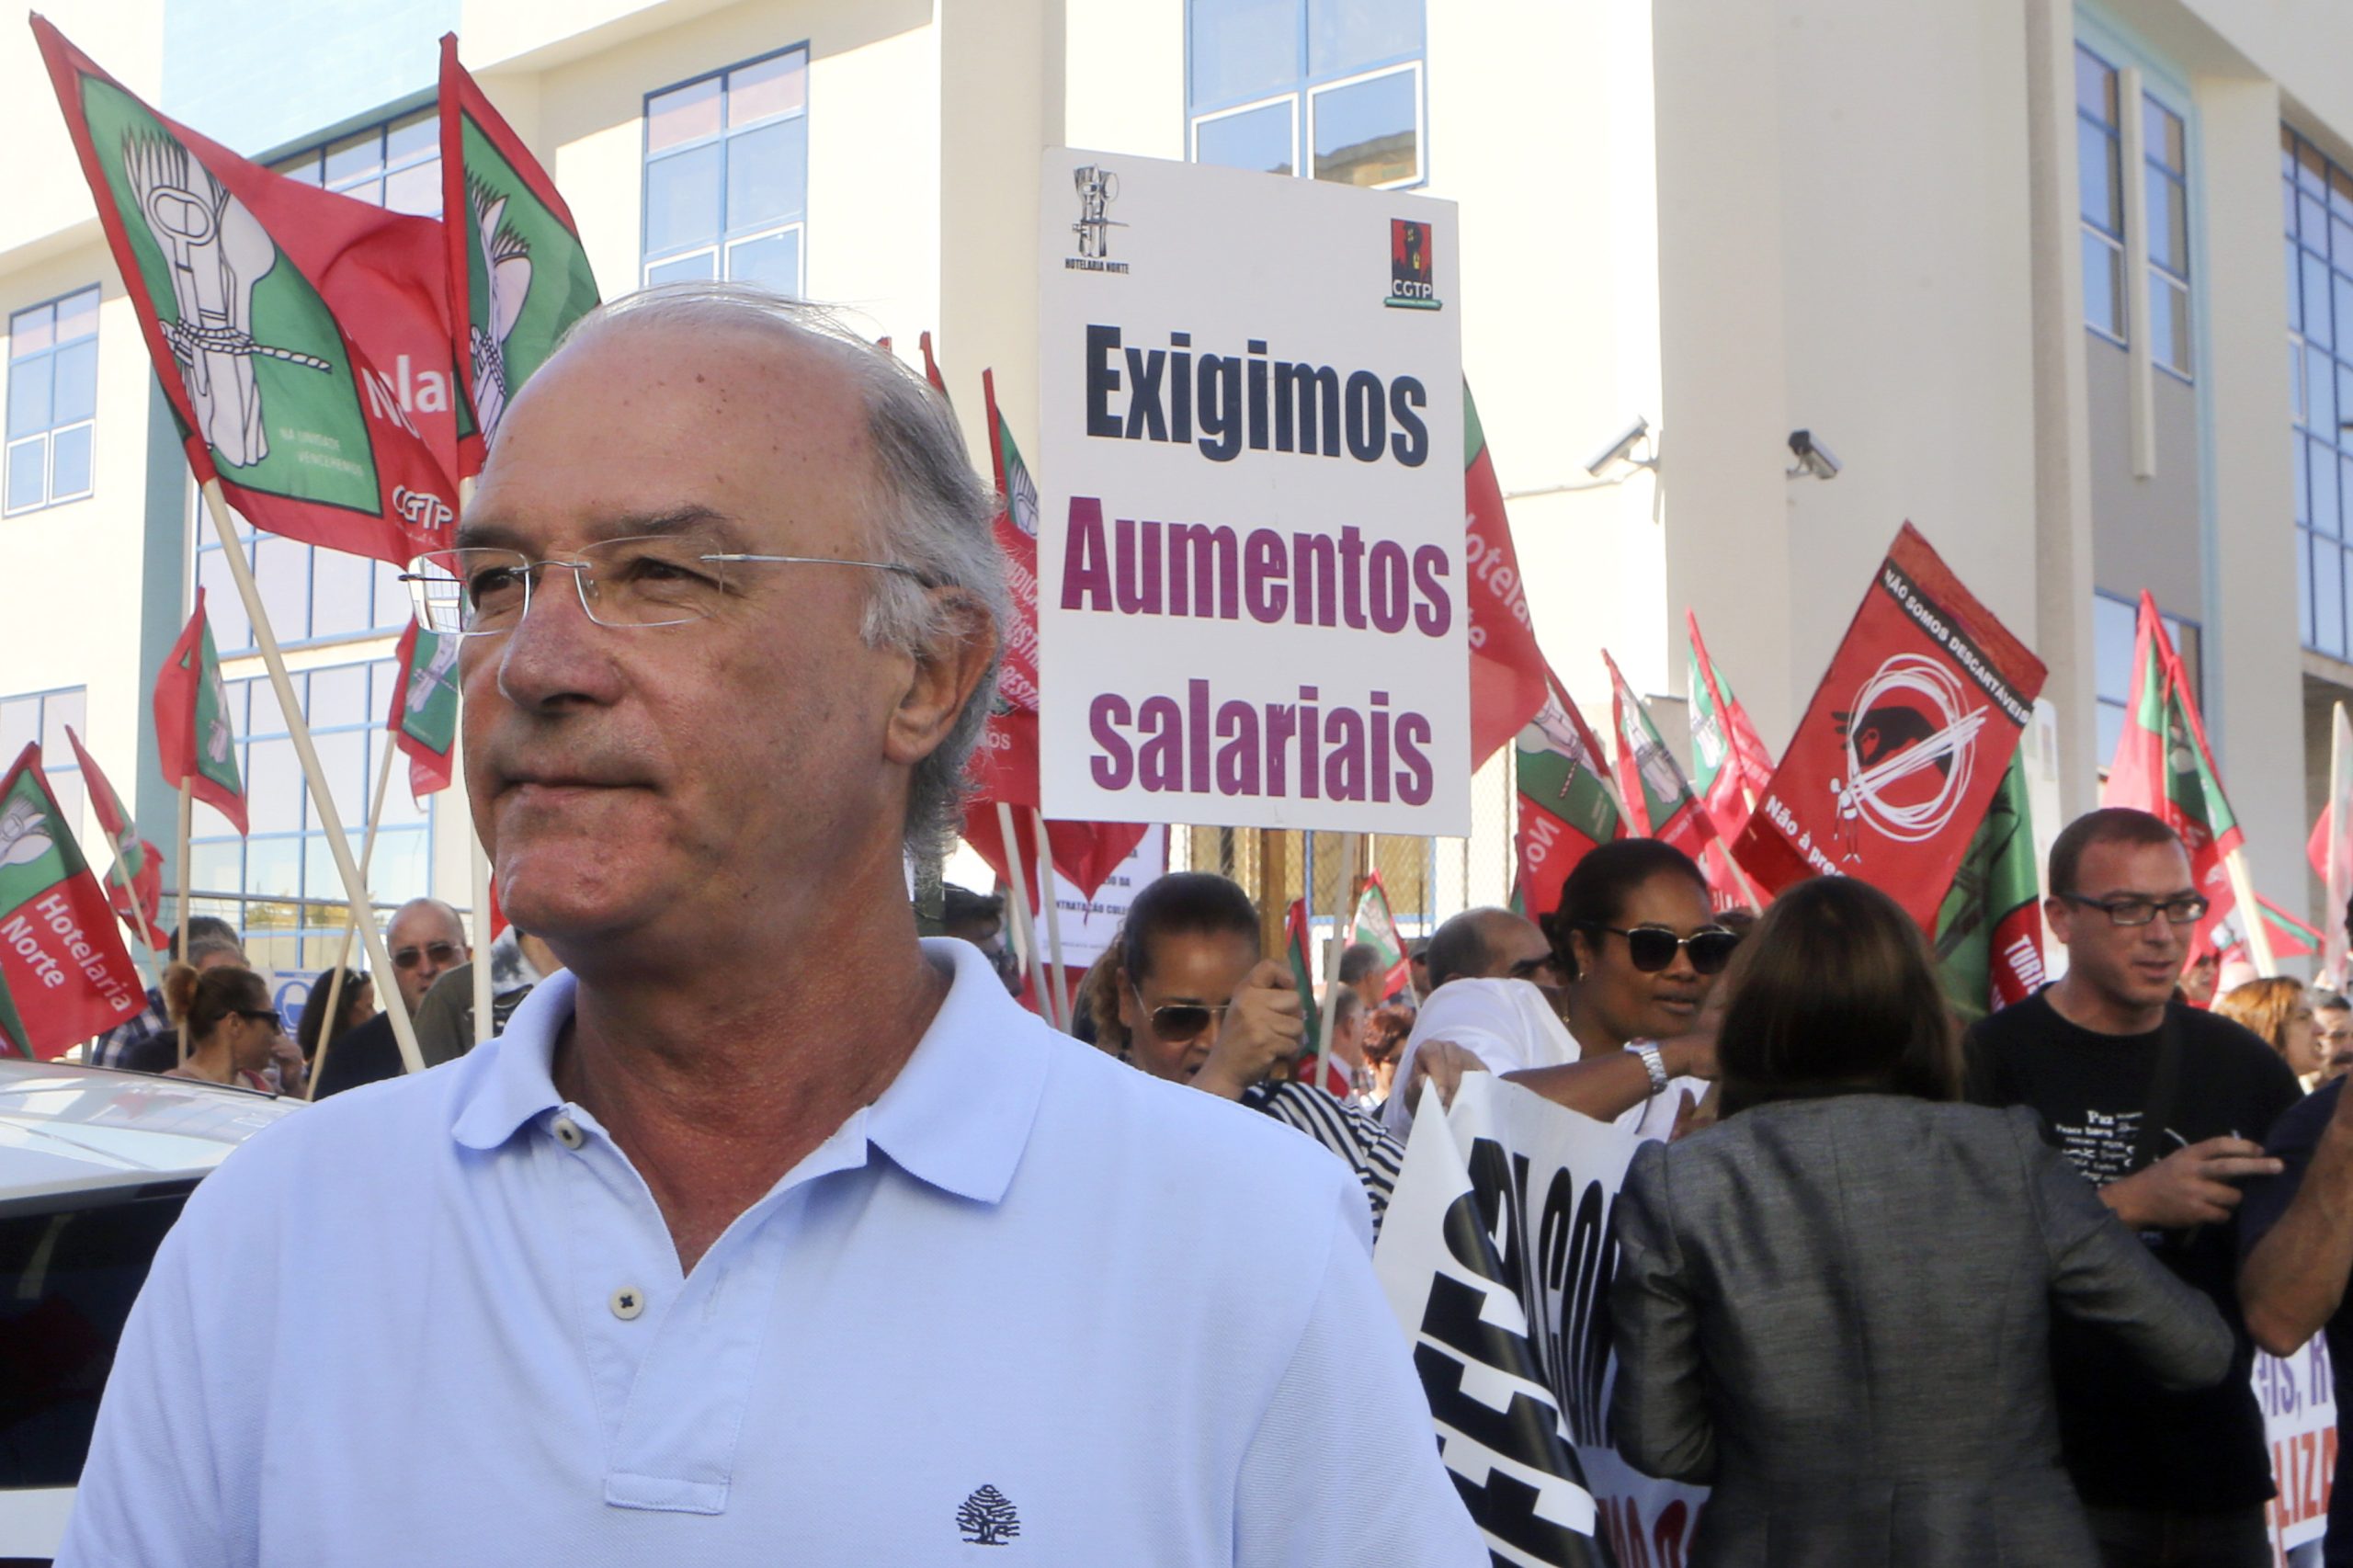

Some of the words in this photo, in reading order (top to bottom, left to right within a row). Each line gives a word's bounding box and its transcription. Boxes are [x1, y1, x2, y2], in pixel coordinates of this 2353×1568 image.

[1392, 278, 1432, 299] CGTP
[1086, 324, 1429, 467] Exigimos
[392, 484, 454, 530] CGTP
[1060, 495, 1451, 638] Aumentos
[1883, 569, 1908, 597] NÃO
[1905, 595, 1949, 642] SOMOS
[1949, 637, 2031, 725] DESCARTÁVEIS
[1088, 678, 1434, 806] salariais
[1765, 794, 1798, 835] Não
[0, 915, 65, 989] Norte
[35, 892, 132, 1012] Hotelaria
